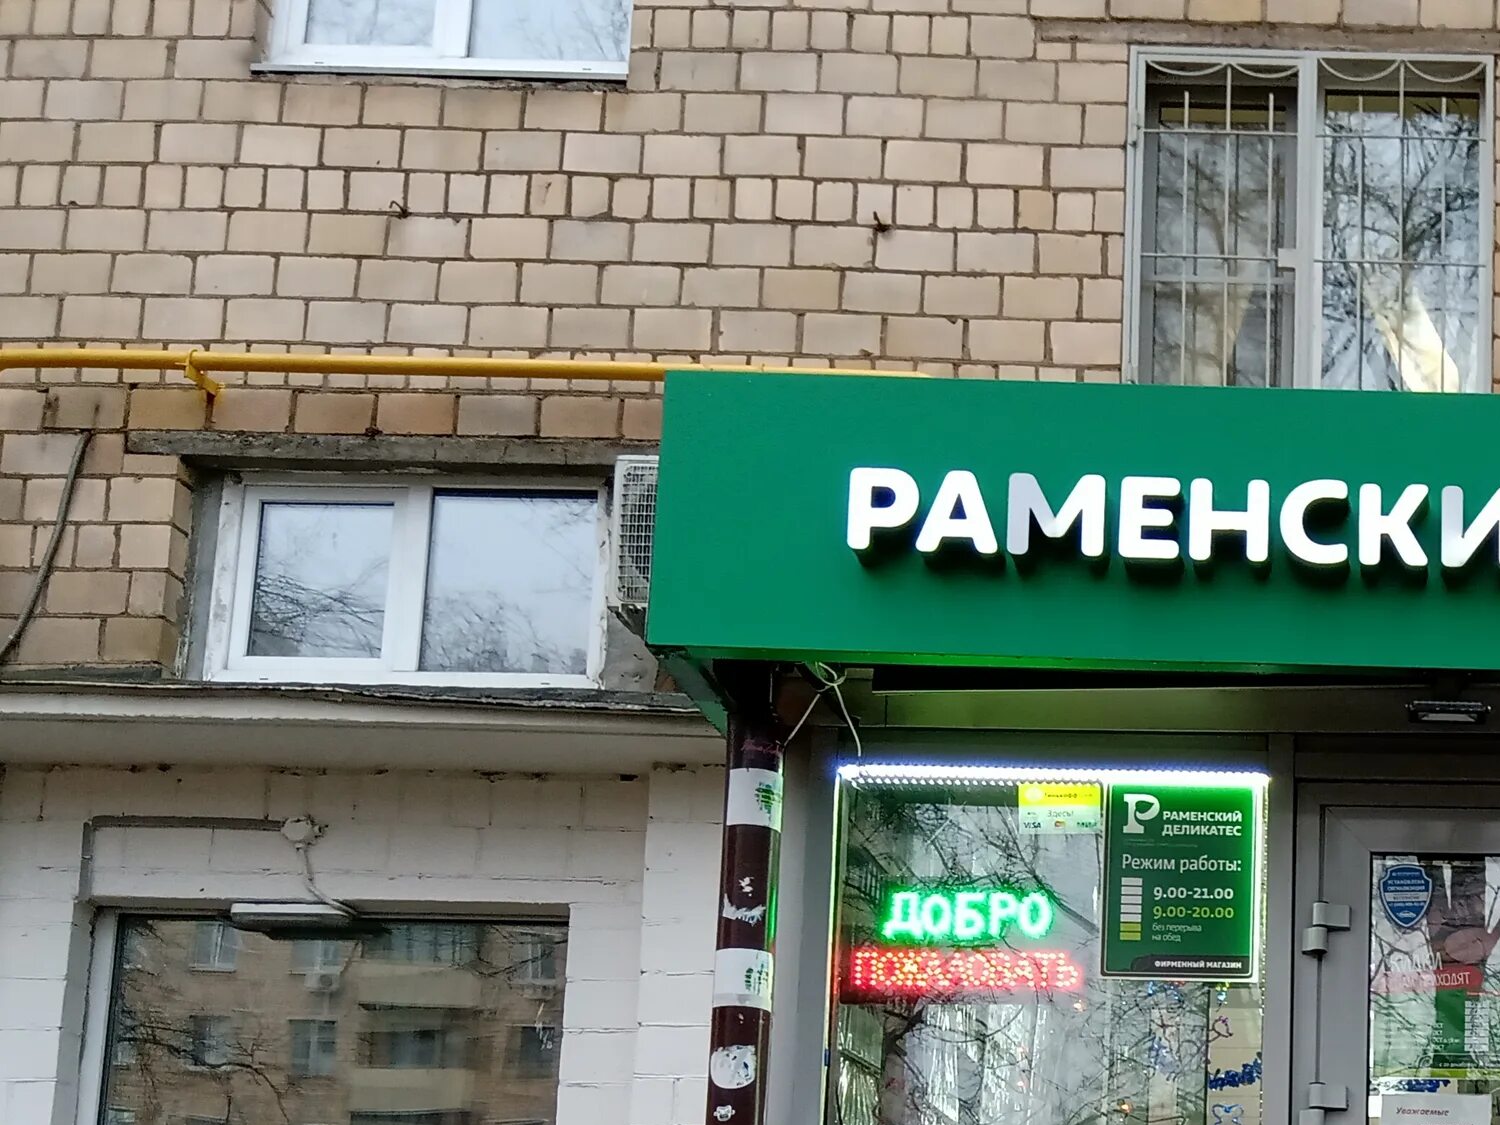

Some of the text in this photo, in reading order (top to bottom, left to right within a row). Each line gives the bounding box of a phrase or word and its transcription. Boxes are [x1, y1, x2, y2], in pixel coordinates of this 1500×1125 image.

[1162, 810, 1242, 822] РАМЕНСКИЙ
[1162, 824, 1242, 836] ДЕЛИКАТЕС
[1122, 853, 1242, 873] Режим работы:
[1153, 887, 1234, 900] 9.00-21.00
[883, 890, 1053, 940] ДОБРО
[1153, 906, 1234, 919] 9.00-20.00
[1154, 959, 1242, 969] ФИРМЕННЫЙ МАГАЗИН
[1396, 1107, 1450, 1117] Уважаемые
